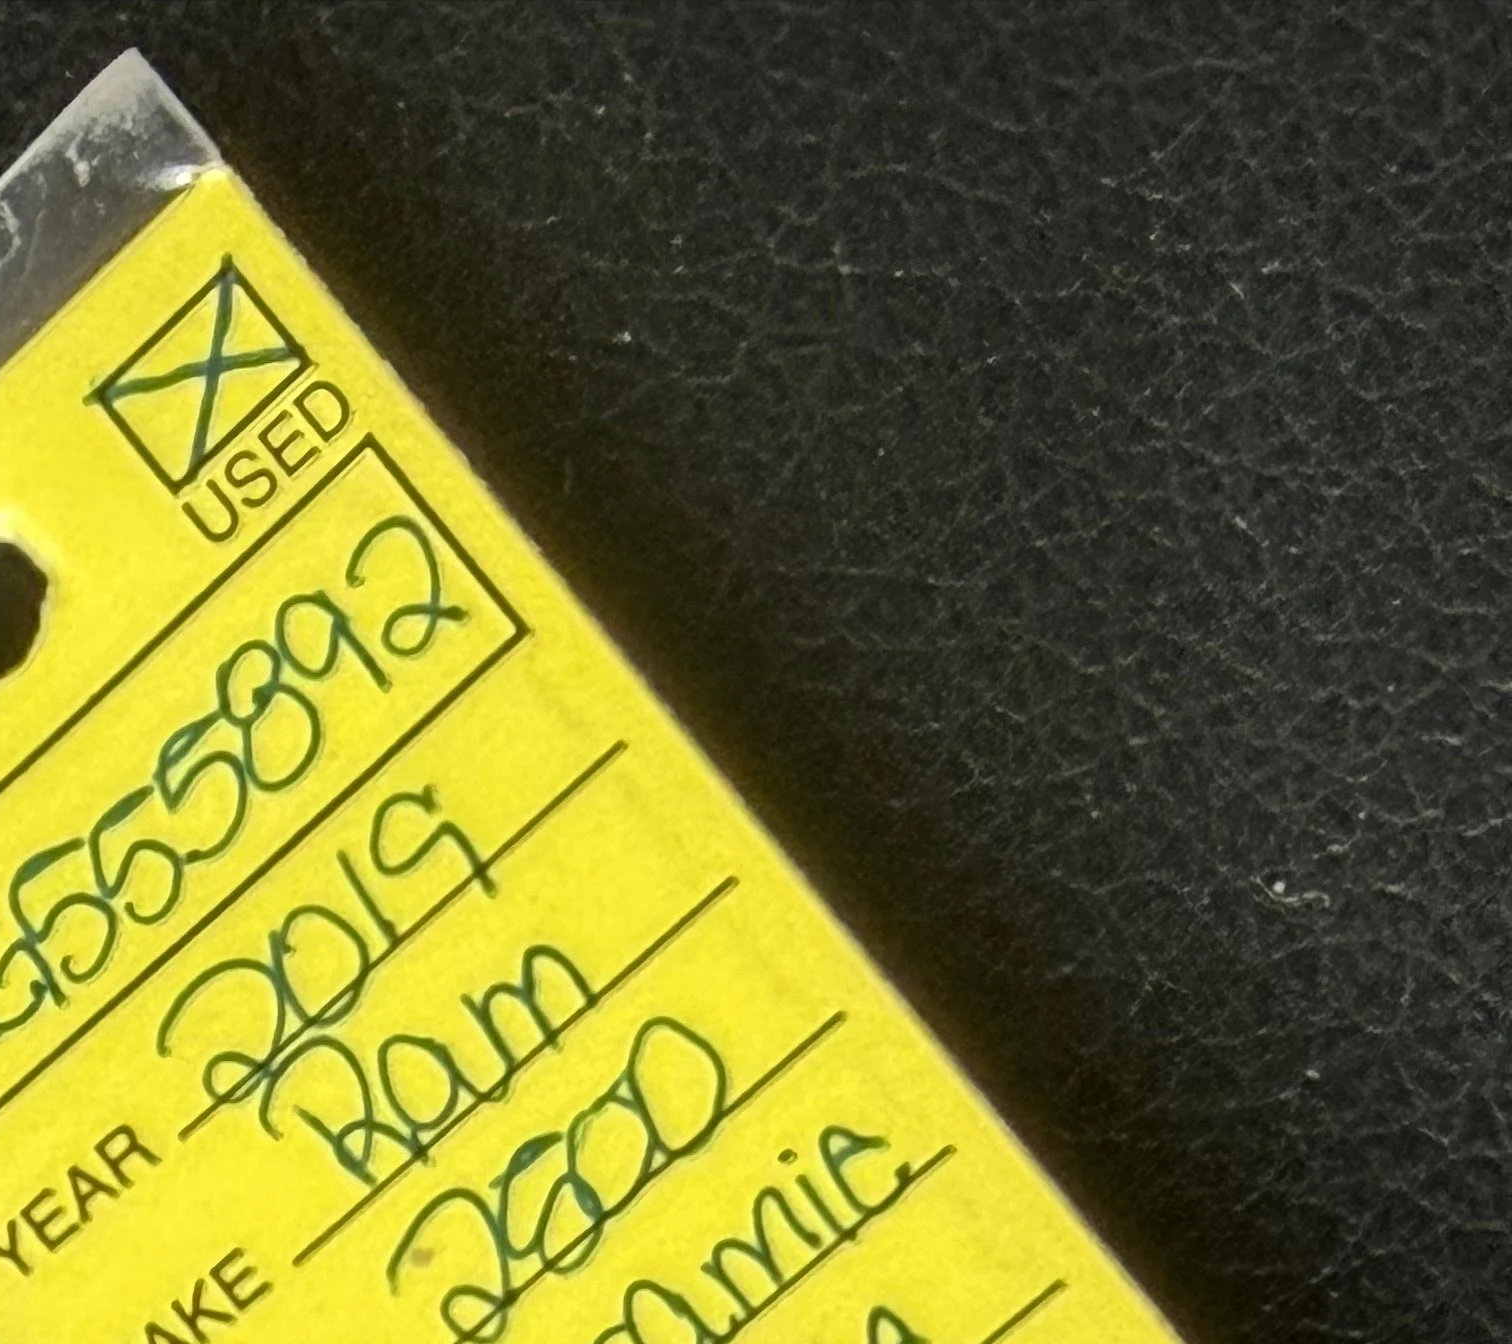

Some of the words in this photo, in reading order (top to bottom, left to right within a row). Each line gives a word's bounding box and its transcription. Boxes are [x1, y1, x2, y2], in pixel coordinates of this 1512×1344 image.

[182, 380, 351, 544] USED
[157, 785, 496, 1106] 2019
[260, 946, 598, 1186] Ram
